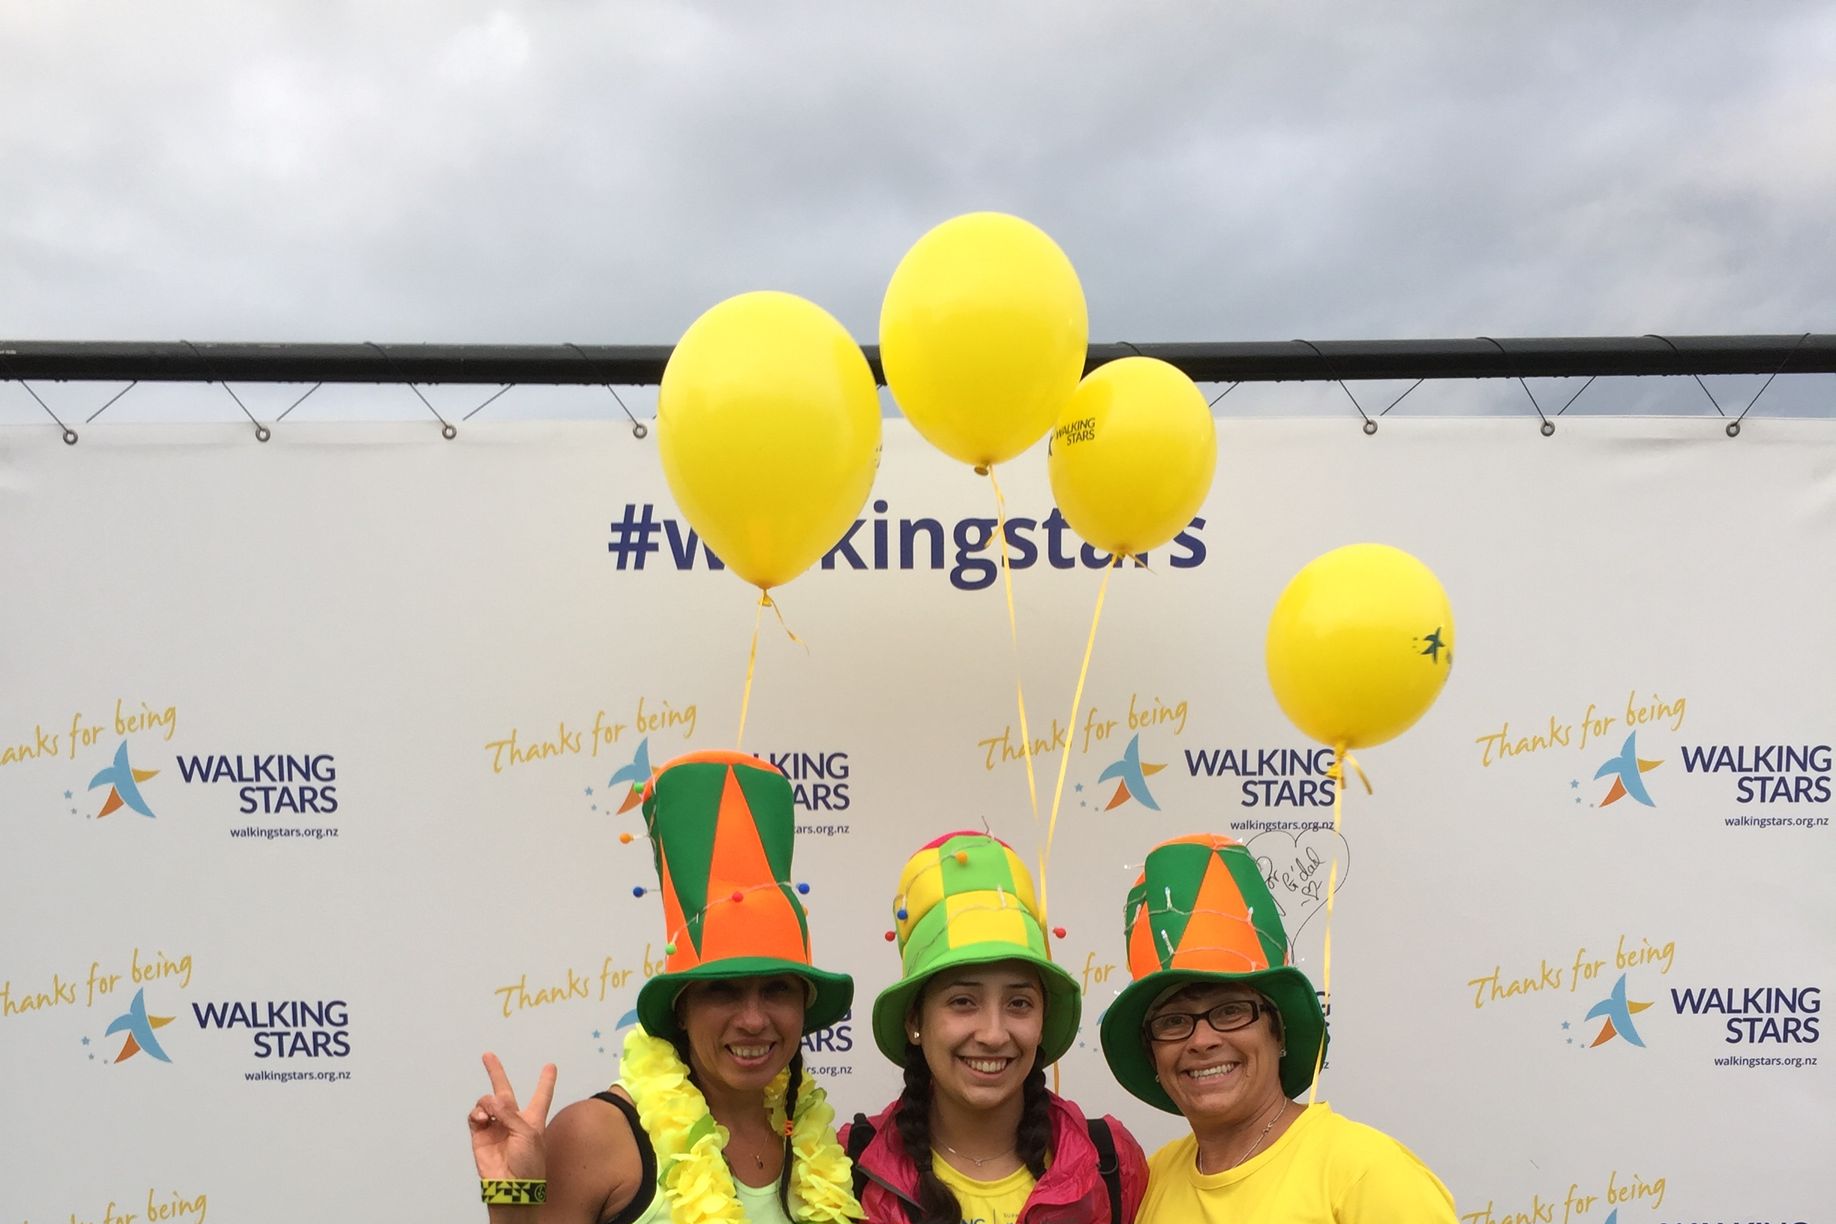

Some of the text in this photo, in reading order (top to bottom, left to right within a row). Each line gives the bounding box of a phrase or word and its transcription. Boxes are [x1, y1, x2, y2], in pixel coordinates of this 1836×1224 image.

[1056, 417, 1096, 439] WALKING
[1066, 429, 1096, 446] STARS
[607, 499, 1208, 591] #wkingsts
[0, 698, 177, 767] anks for being
[484, 696, 697, 774] Thanks for being
[1082, 707, 1118, 753] for
[1127, 692, 1188, 734] being
[1474, 689, 1687, 768] Thanks for being
[176, 754, 337, 783] WALKING
[753, 752, 850, 780] KING
[1184, 748, 1336, 777] WALKING
[1681, 745, 1833, 773] WALKING
[239, 786, 339, 814] STARS
[793, 783, 851, 811] ARS
[1240, 780, 1336, 807] STARS
[1736, 776, 1833, 804] STARS
[230, 826, 339, 840] walkingstars.org.nz
[794, 824, 850, 837] ars.org.nz
[1230, 819, 1335, 832] walkingstars.org.nz
[1724, 816, 1830, 829] walkingstars.org.nz
[0, 947, 192, 1017] hanks for being
[1082, 952, 1116, 996] for
[1467, 933, 1676, 1009] Thanks for being
[495, 969, 590, 1018] Thanks
[599, 956, 633, 1002] for
[1670, 987, 1821, 1014] WALKING
[191, 1000, 350, 1029] WALKING
[800, 1026, 854, 1052] ARS
[1725, 1017, 1820, 1044] STARS
[253, 1031, 351, 1059] STARS
[1714, 1055, 1818, 1068] walkingstars.org.nz
[245, 1070, 352, 1083] walkingstars.org.nz
[1606, 1170, 1667, 1209] being
